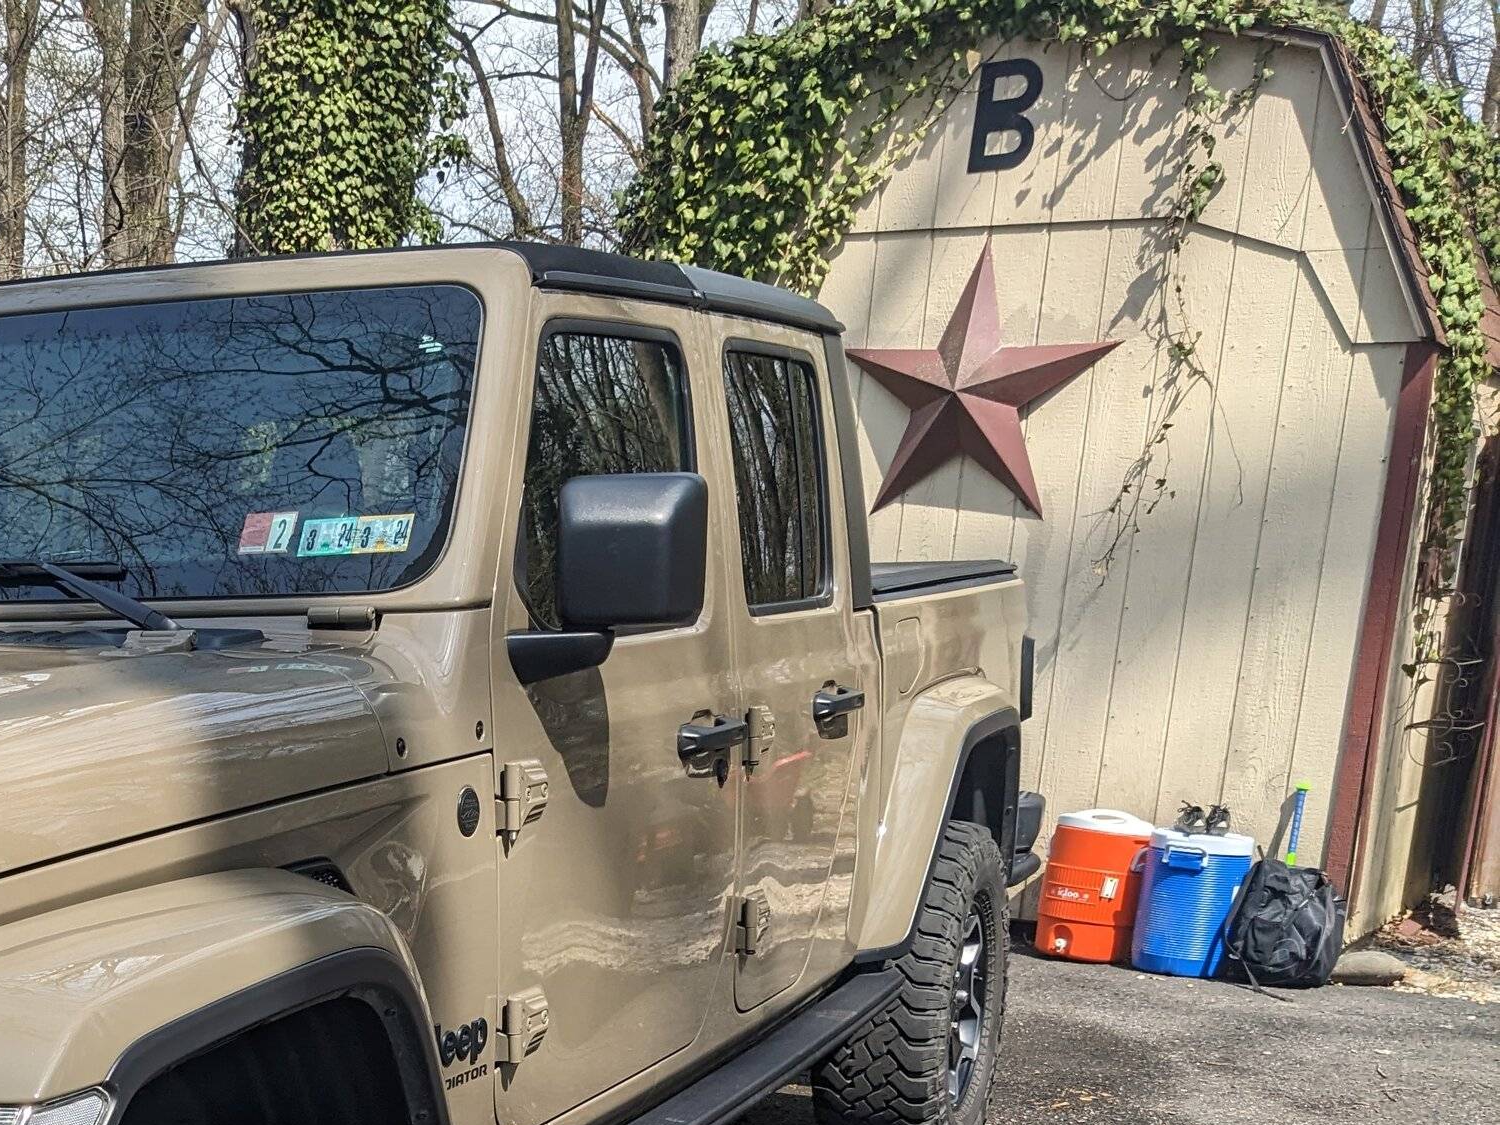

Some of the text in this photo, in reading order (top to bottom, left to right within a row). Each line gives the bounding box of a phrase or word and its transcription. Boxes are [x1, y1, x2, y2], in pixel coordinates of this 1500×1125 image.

[967, 58, 1043, 174] B
[273, 519, 287, 549] 2
[306, 523, 354, 551] 3 24
[361, 520, 409, 548] 3 24
[445, 1064, 488, 1091] DIATOR
